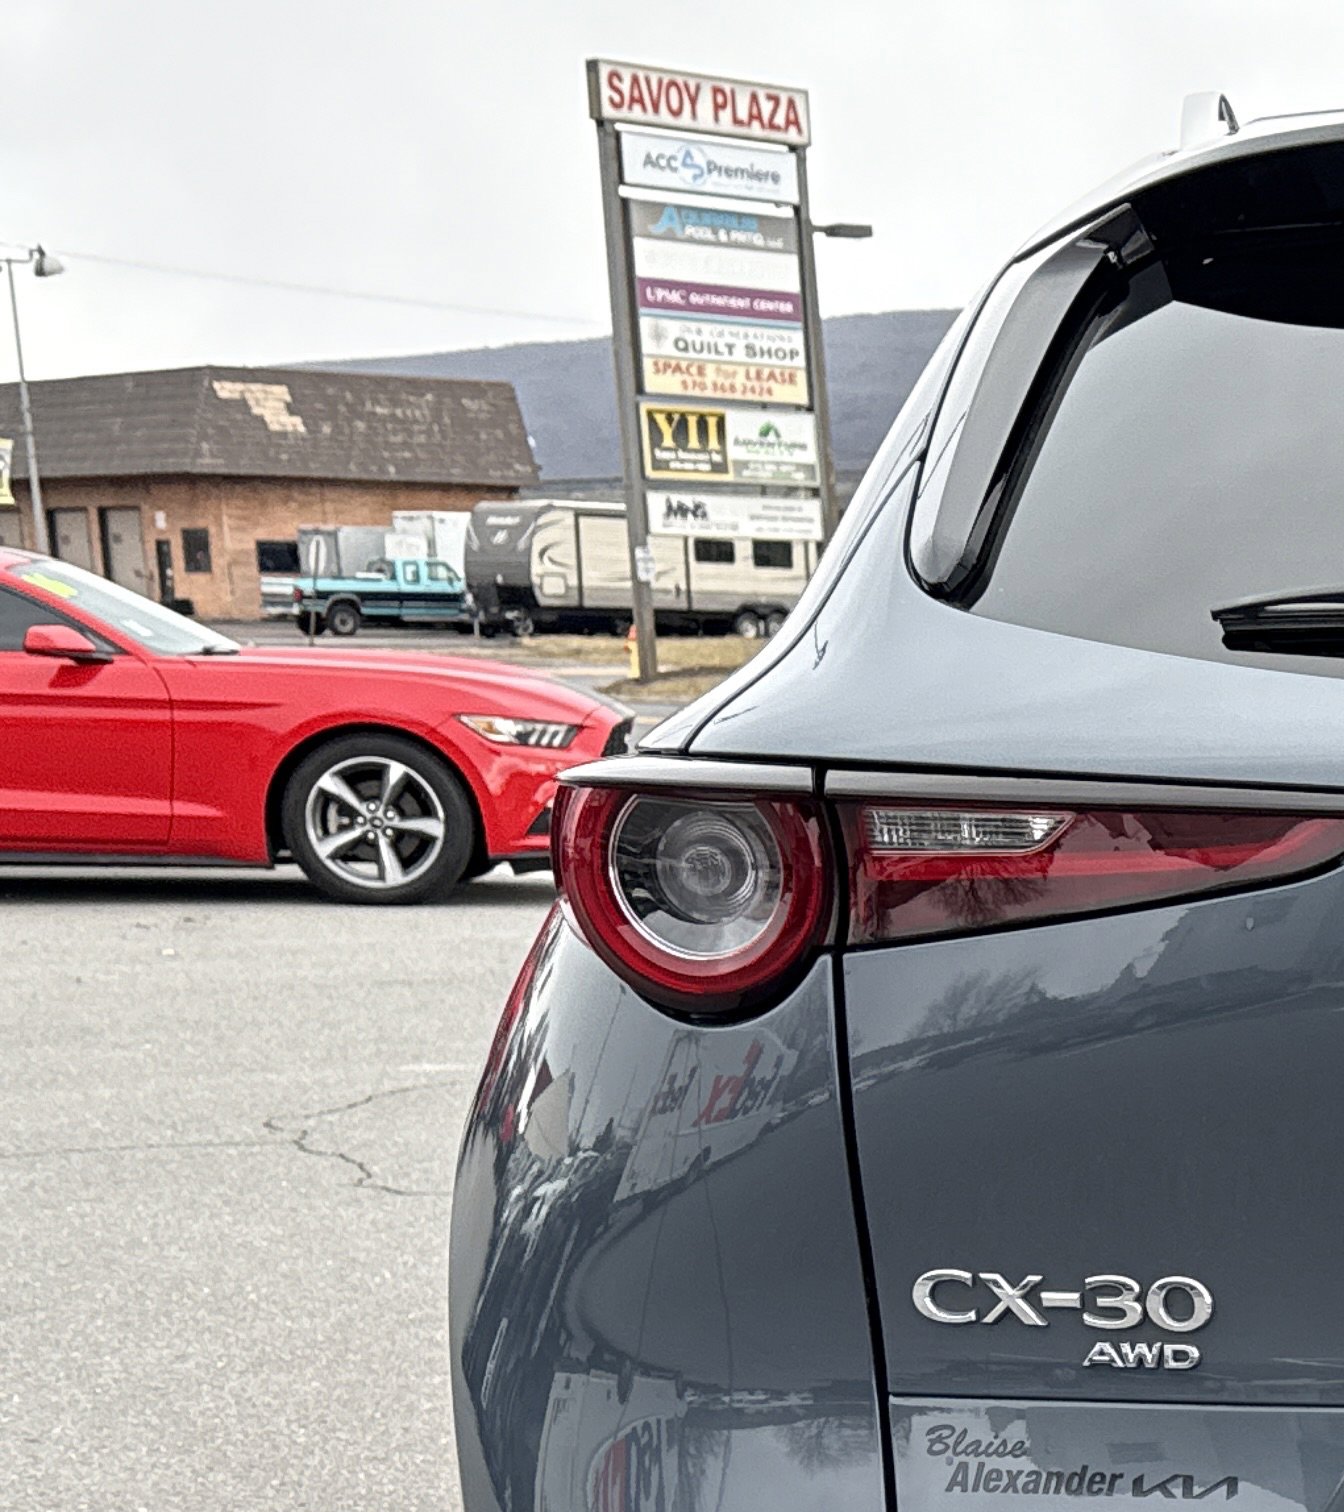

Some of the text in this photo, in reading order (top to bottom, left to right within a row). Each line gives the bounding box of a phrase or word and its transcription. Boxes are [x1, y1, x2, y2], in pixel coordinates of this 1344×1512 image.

[607, 69, 803, 135] SAVOY PLAZA
[643, 151, 781, 185] ACC Premiere
[673, 336, 800, 361] QUILT SHOP
[652, 360, 707, 378] SPACE
[744, 367, 798, 386] LEASE
[911, 1267, 1214, 1333] CX-30
[1081, 1340, 1201, 1370] AWD
[924, 1423, 1030, 1459] Blaise
[944, 1461, 1125, 1497] Alexander
